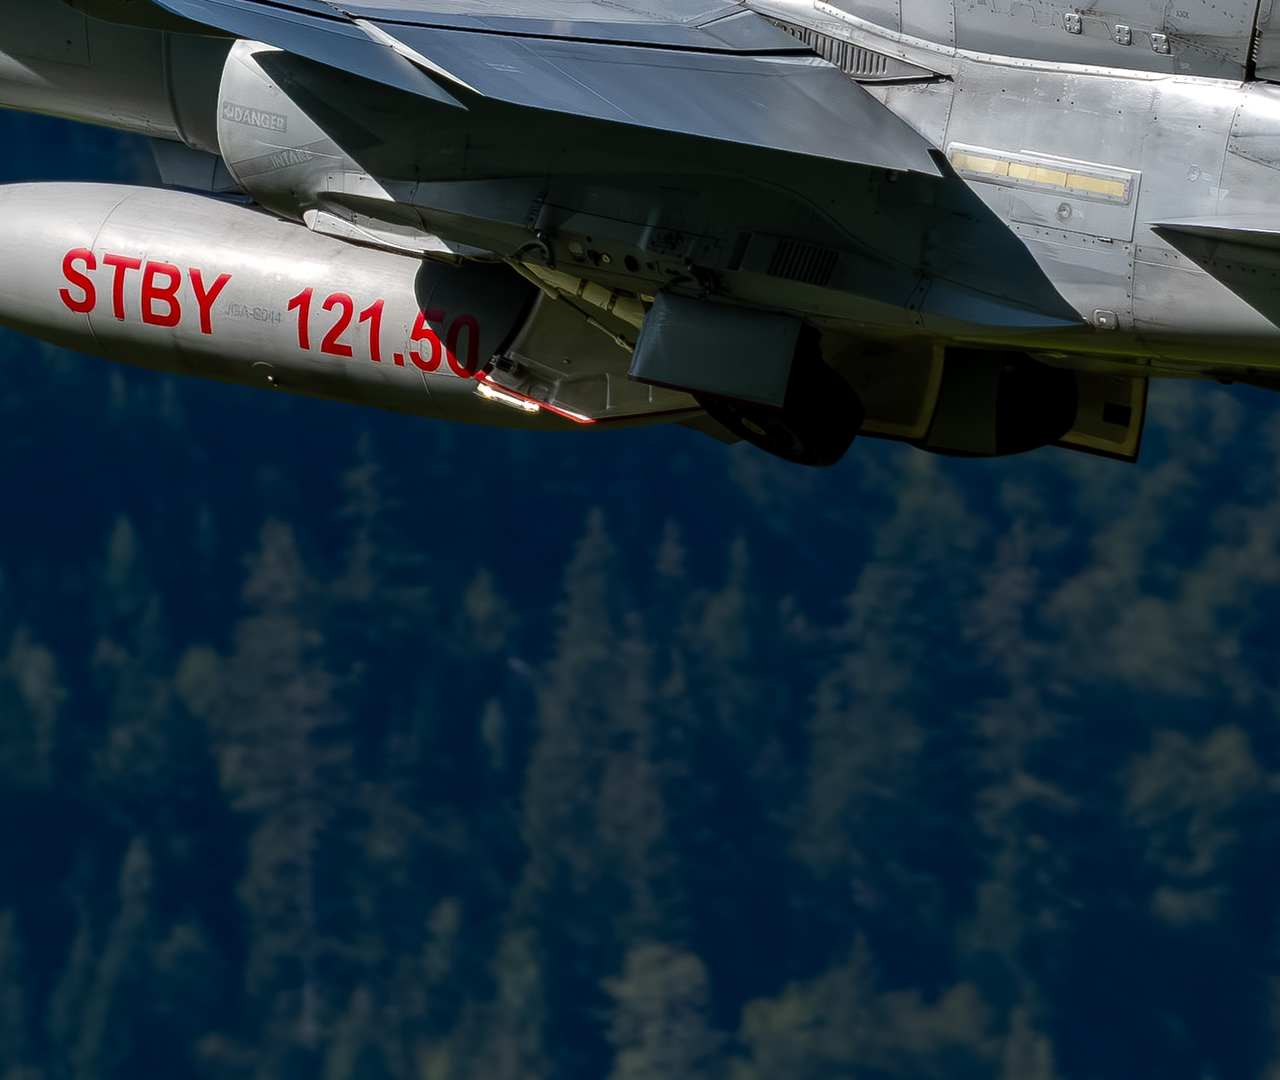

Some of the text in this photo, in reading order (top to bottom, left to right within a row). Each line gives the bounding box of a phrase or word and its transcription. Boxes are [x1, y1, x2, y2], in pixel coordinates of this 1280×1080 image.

[234, 106, 285, 131] DANGER
[58, 246, 480, 379] STBY 121.50
